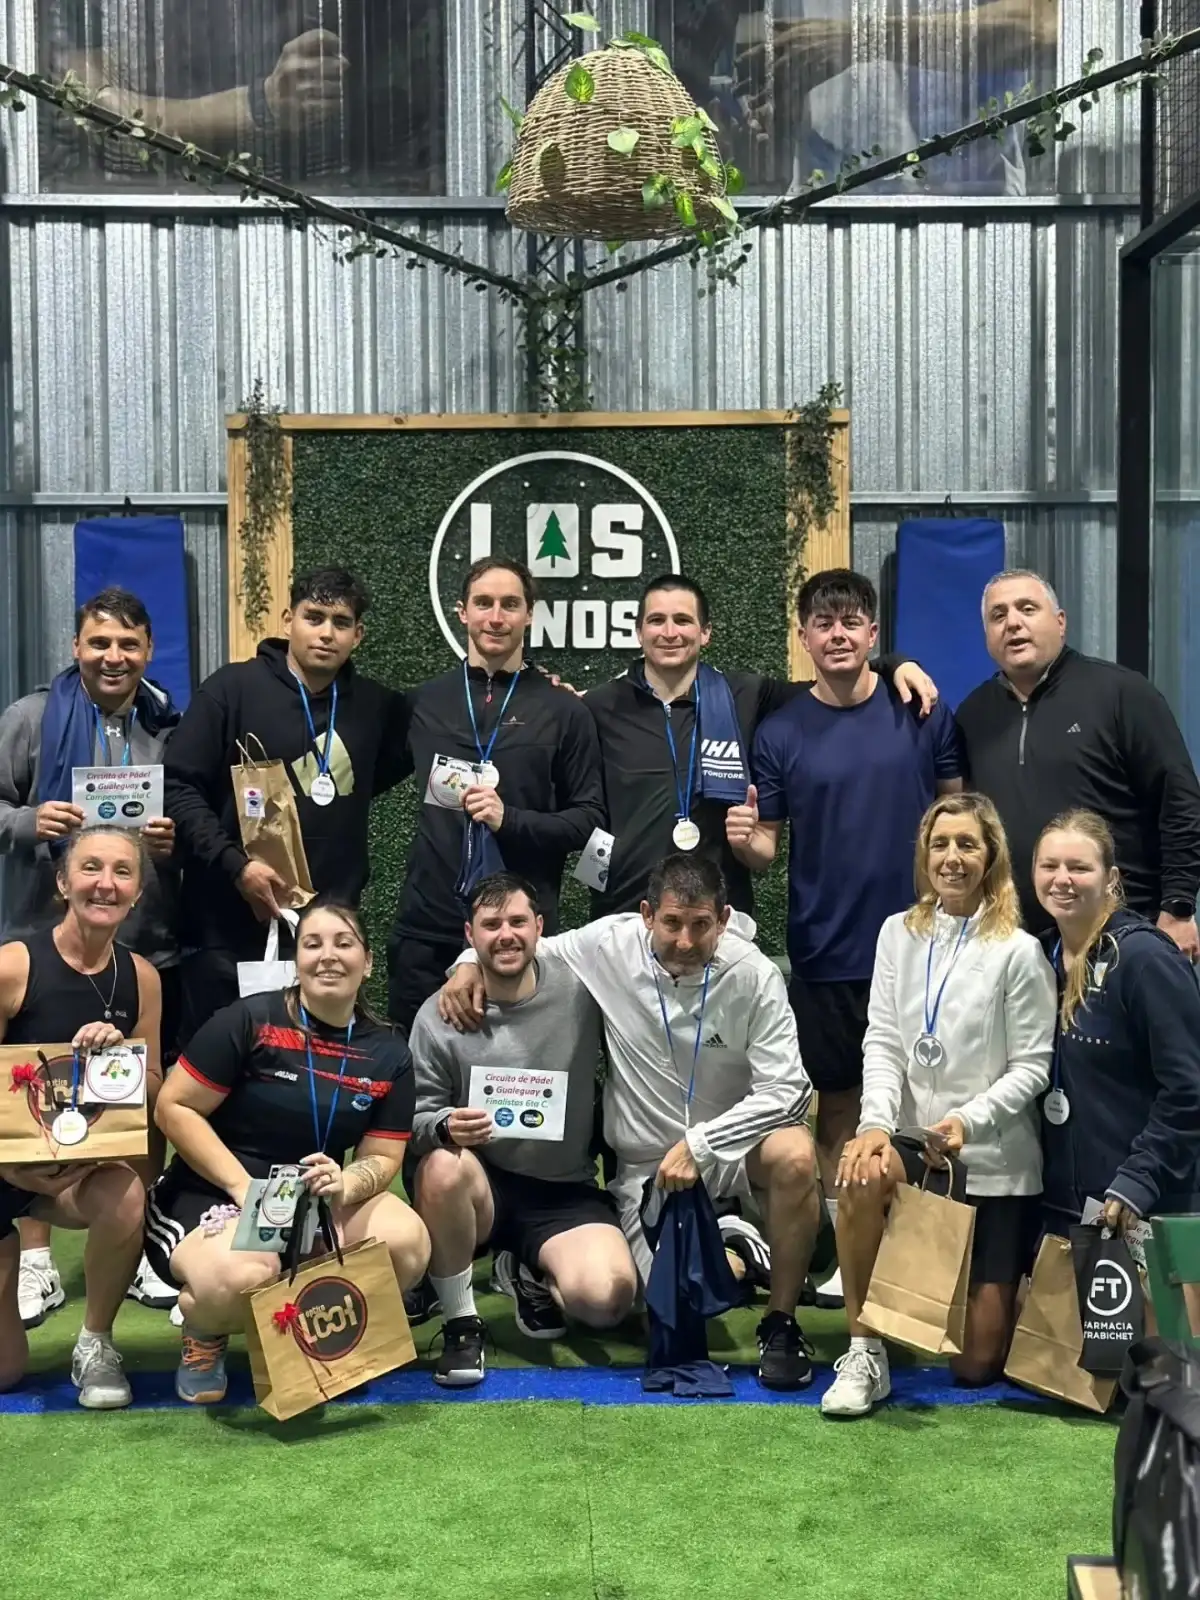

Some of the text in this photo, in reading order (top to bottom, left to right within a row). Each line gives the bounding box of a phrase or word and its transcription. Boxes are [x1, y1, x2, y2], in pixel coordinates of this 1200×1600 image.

[530, 600, 642, 649] NOS
[98, 782, 139, 791] Gualeguay
[85, 793, 130, 801] Campeones
[485, 1073, 516, 1083] Circuito
[518, 1075, 529, 1084] de
[496, 1086, 541, 1097] Gualeguay
[485, 1097, 523, 1107] Finalistas
[525, 1099, 539, 1108] 6ta
[1090, 1277, 1122, 1300] FT
